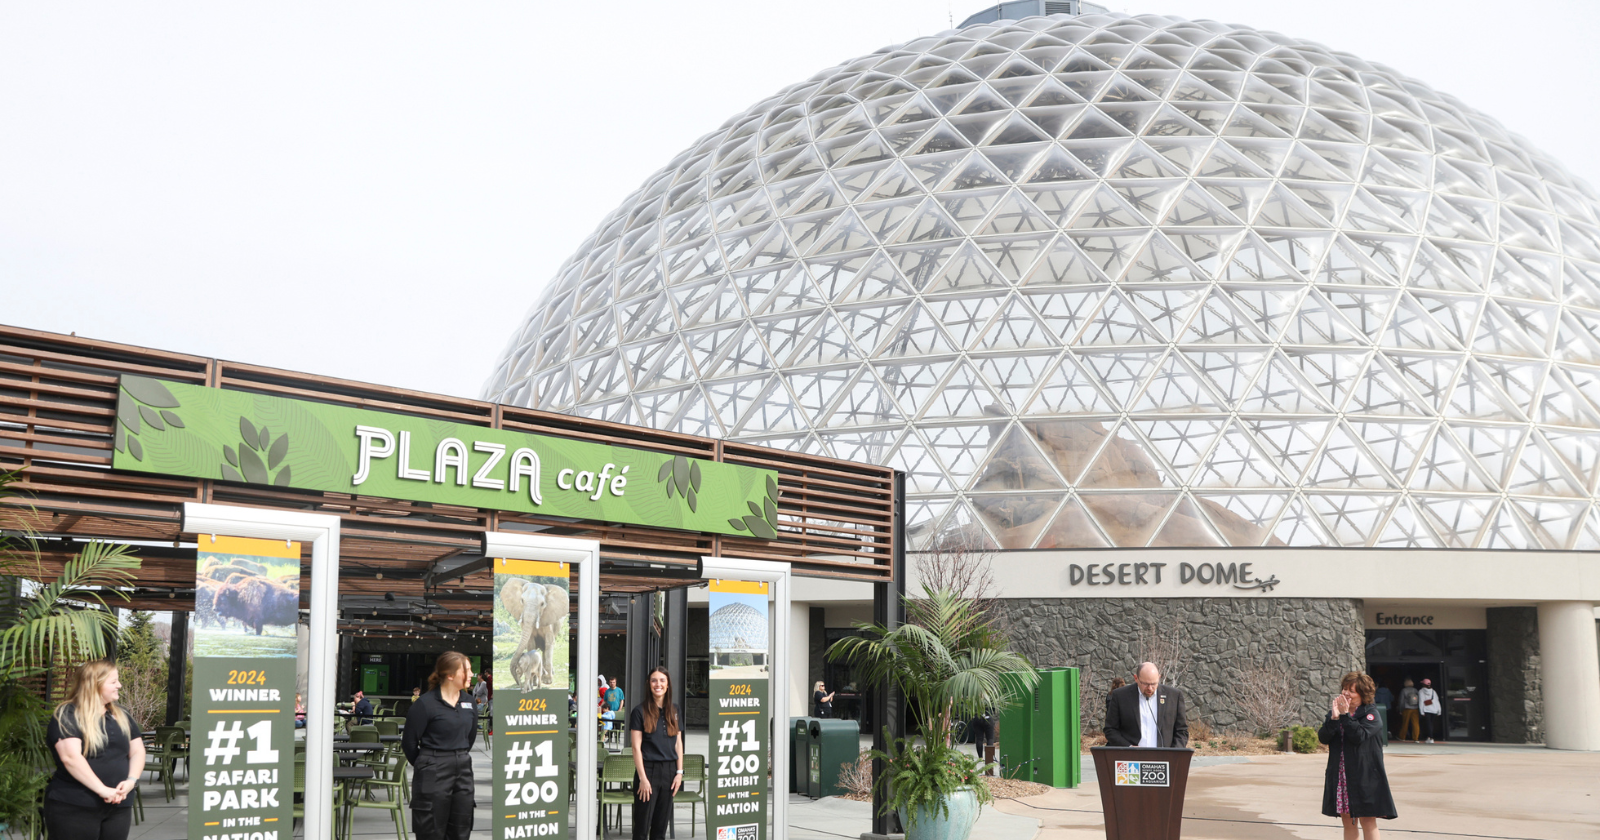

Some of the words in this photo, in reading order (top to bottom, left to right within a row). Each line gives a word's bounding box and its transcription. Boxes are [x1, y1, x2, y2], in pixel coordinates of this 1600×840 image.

[352, 425, 542, 505] PLAZA
[557, 463, 629, 500] café
[1069, 562, 1167, 586] DESERT
[1180, 562, 1253, 585] DOME
[1376, 612, 1434, 625] Entrance
[227, 670, 266, 686] 2024
[209, 688, 280, 702] WINNER
[729, 684, 751, 696] 2024
[518, 699, 547, 711] 2024
[719, 698, 760, 707] WINNER
[505, 714, 558, 726] WINNER
[204, 720, 279, 765] #1
[718, 720, 760, 753] #1
[504, 740, 558, 779] #1
[718, 754, 759, 775] ZOO
[204, 769, 278, 786] SAFARI
[718, 775, 759, 788] EXHIBIT
[1142, 772, 1165, 780] ZOO
[203, 788, 279, 811] PARK
[505, 780, 558, 806] ZOO
[519, 812, 528, 820] IN
[529, 810, 545, 818] THE
[717, 802, 759, 816] NATION
[223, 818, 235, 827] IN
[238, 816, 260, 826] THE
[504, 822, 558, 840] NATION
